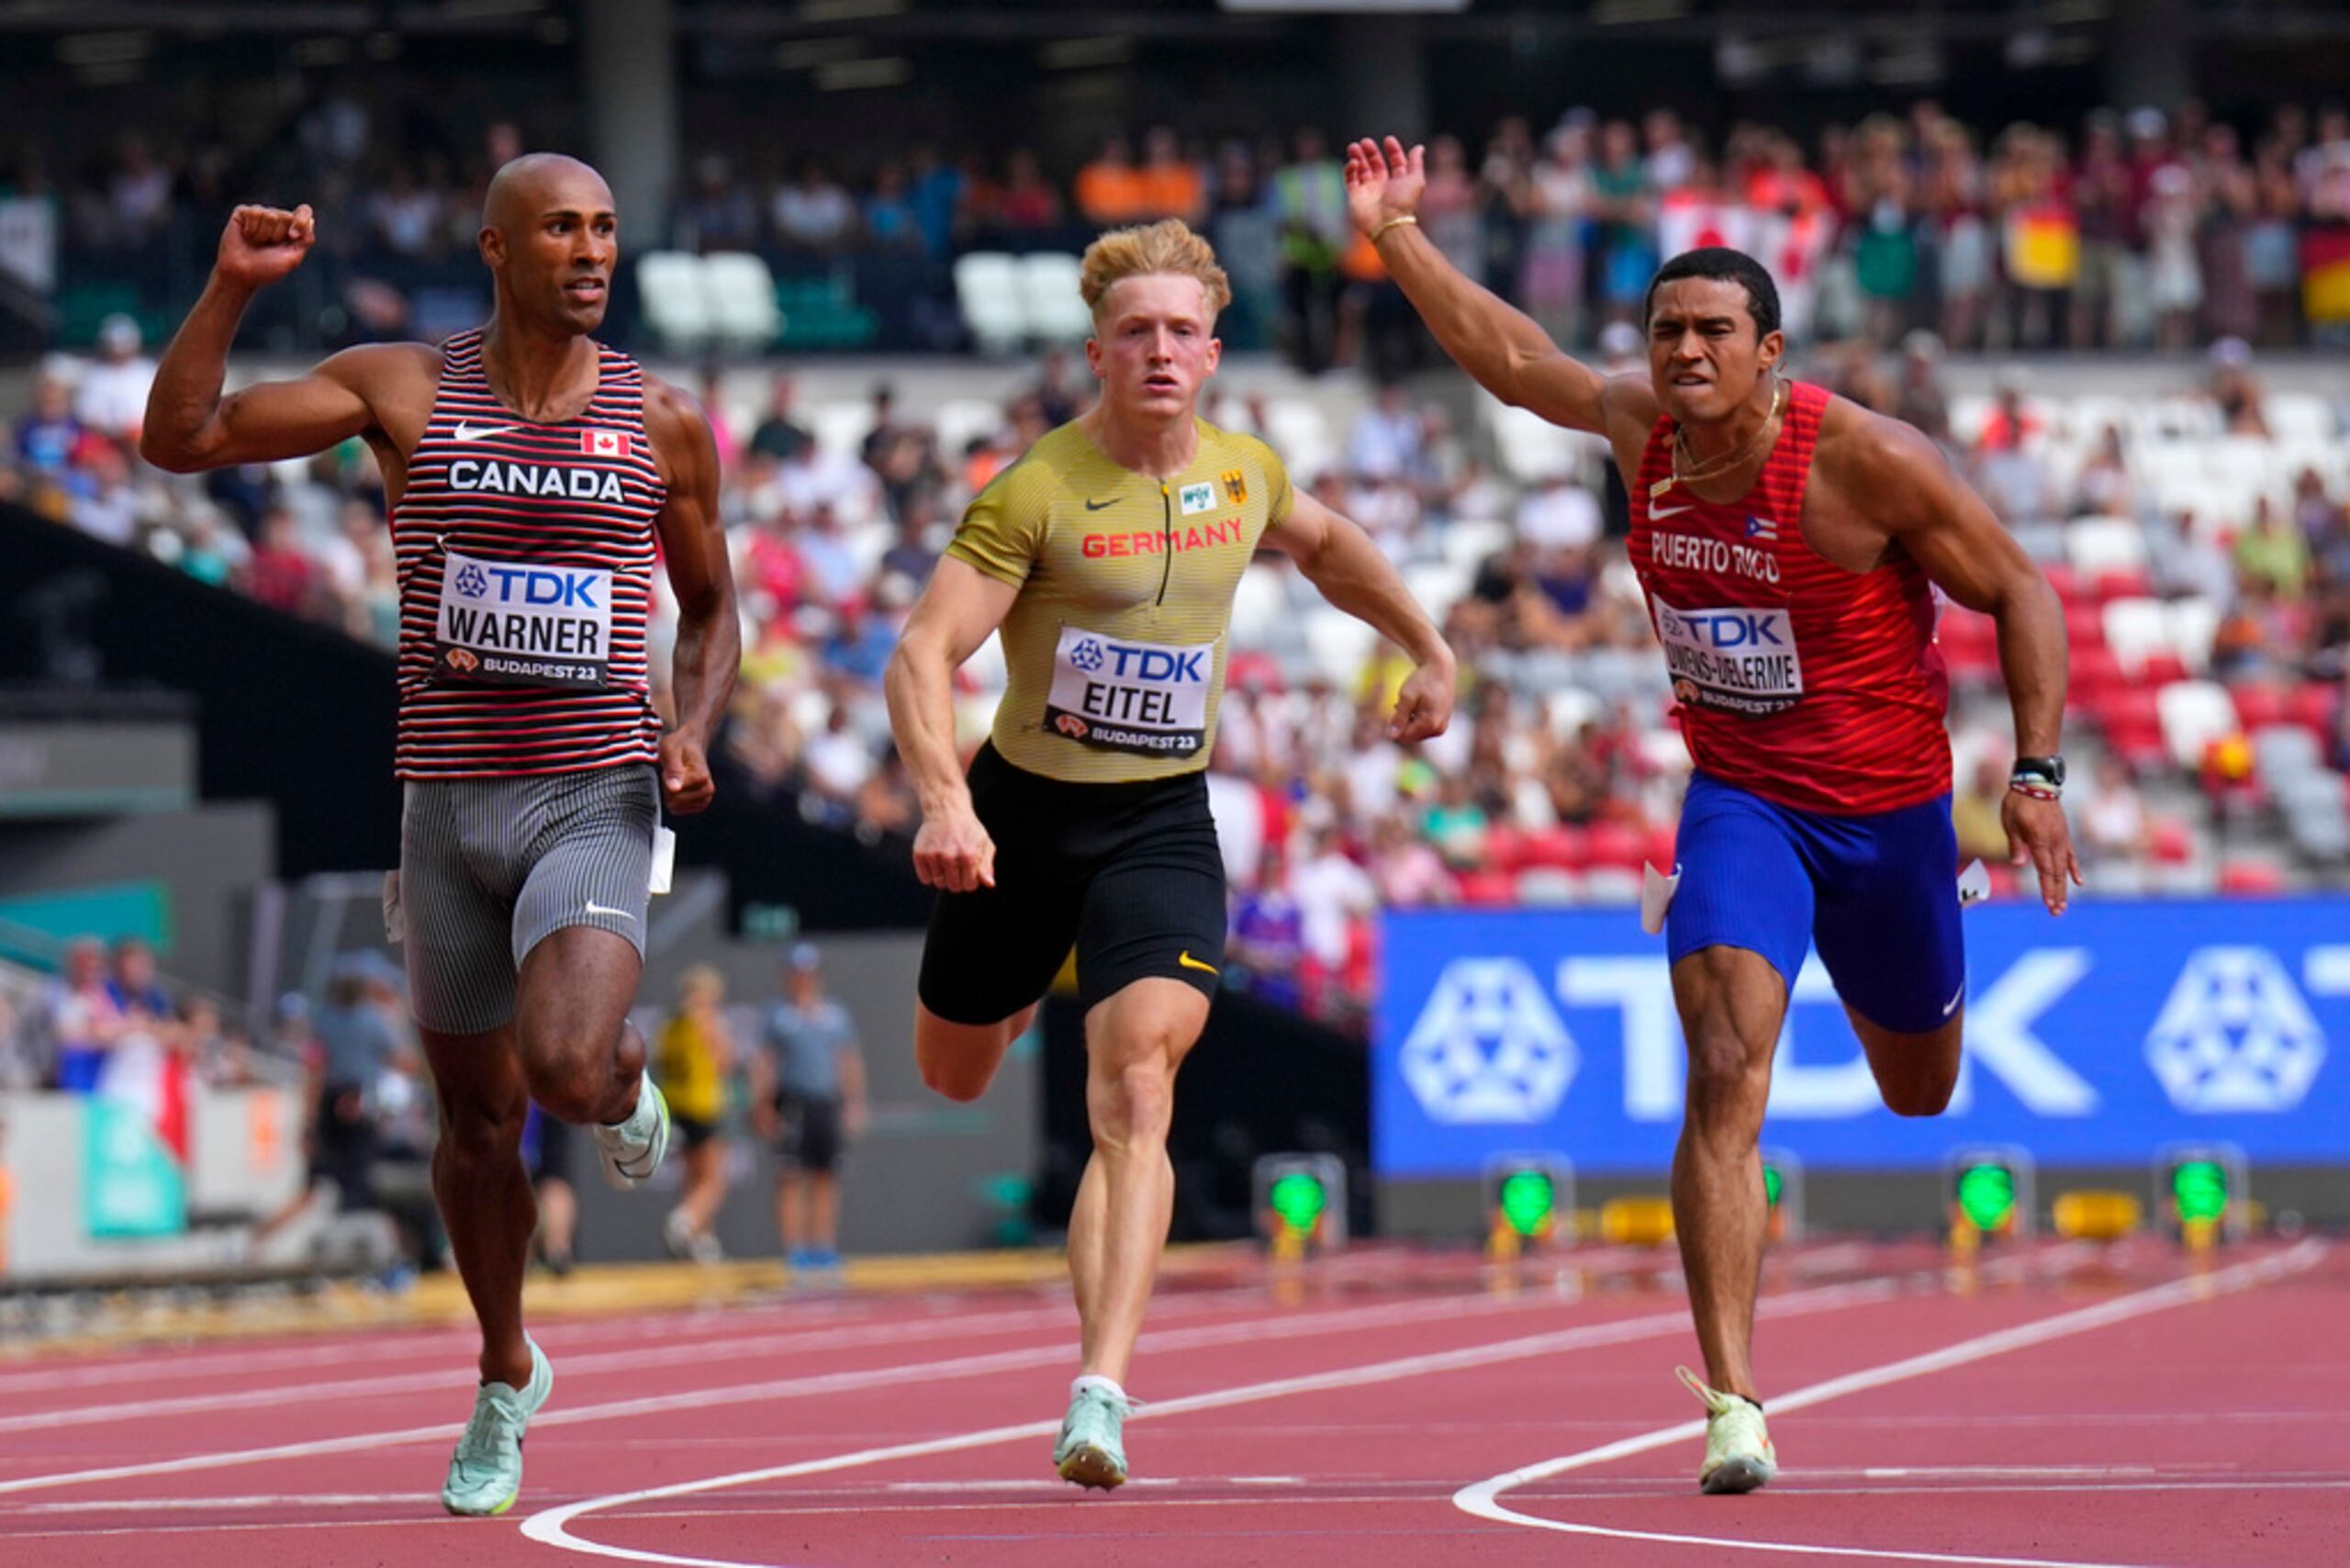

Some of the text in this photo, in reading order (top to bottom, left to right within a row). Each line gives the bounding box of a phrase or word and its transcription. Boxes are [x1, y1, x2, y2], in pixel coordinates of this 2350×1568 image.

[450, 461, 623, 502] CANADA
[1081, 517, 1243, 558] GERMANY
[1652, 532, 1780, 584] PUERTO RICO
[488, 568, 598, 607] TDK
[447, 605, 599, 655] WARNER
[1678, 614, 1783, 647] TDK
[484, 657, 597, 680] BUDAPEST 23
[1107, 645, 1203, 683] TDK
[1082, 682, 1175, 723] EITEL
[1092, 727, 1195, 750] BUDAPEST 23
